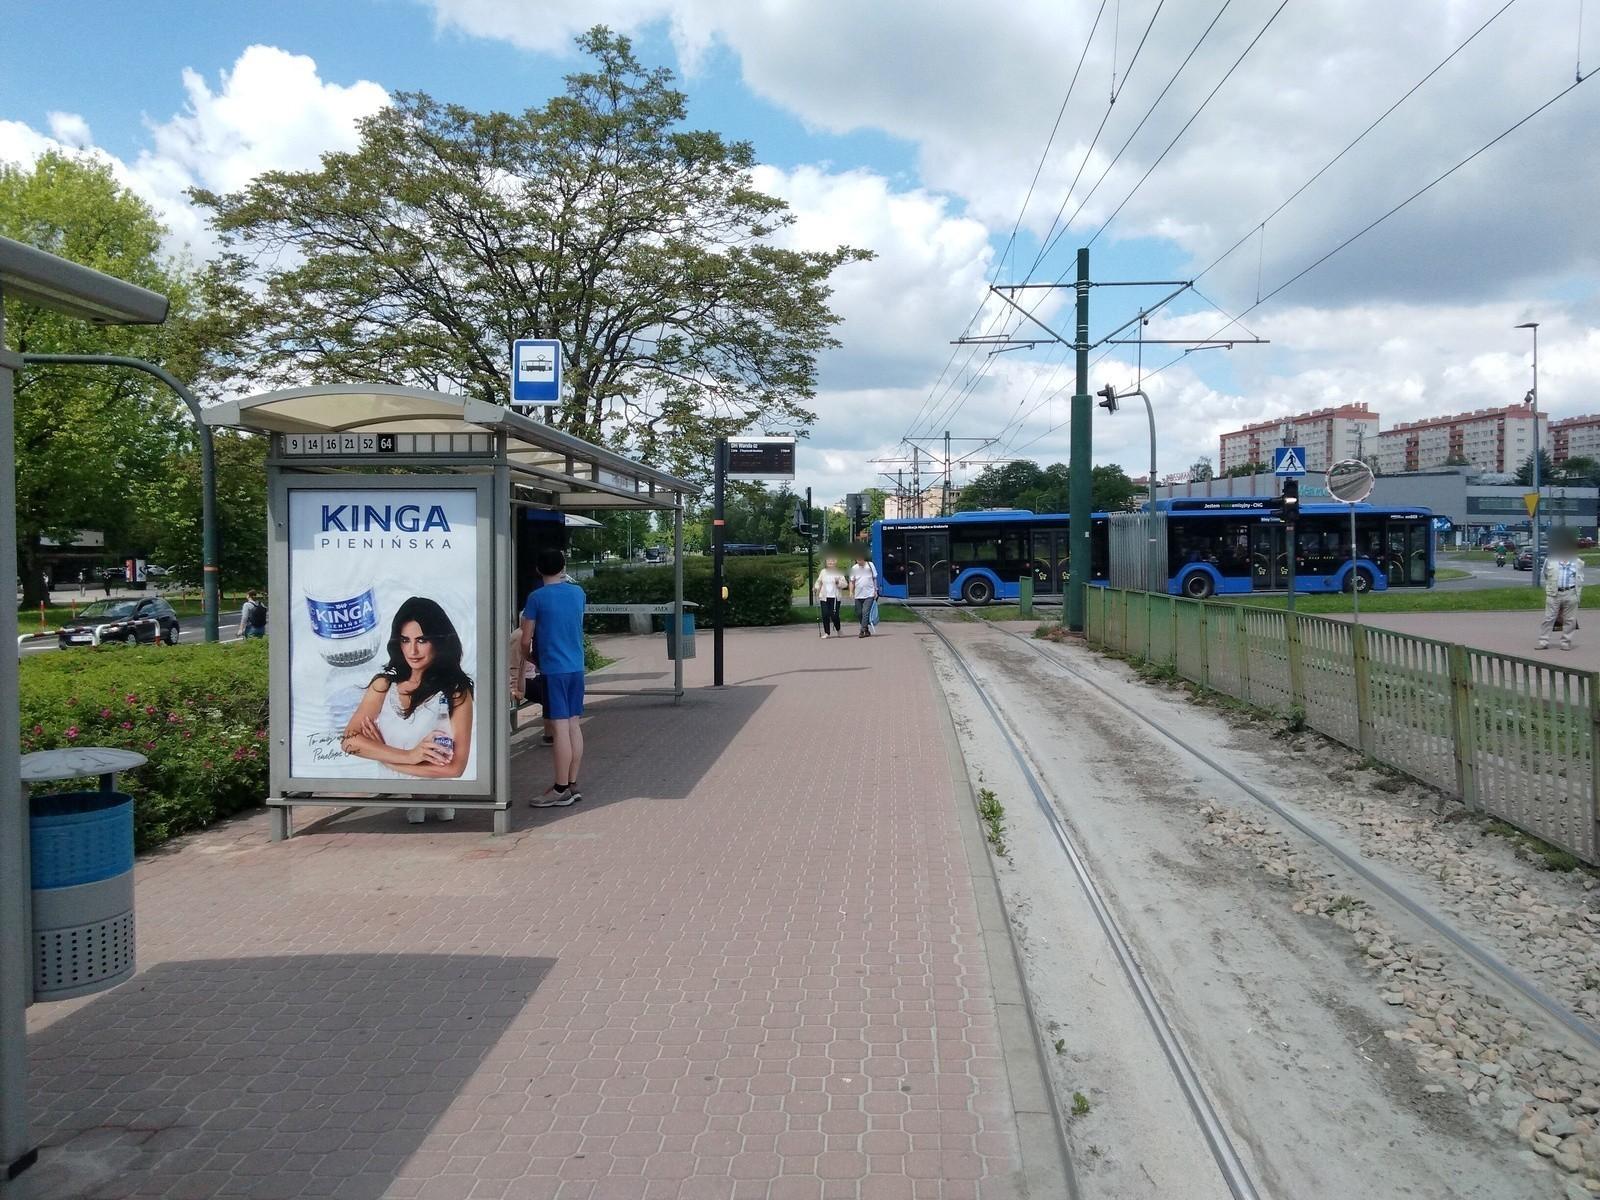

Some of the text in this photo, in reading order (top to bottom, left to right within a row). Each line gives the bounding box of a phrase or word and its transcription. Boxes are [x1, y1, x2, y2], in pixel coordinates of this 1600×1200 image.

[292, 438, 392, 450] 9 14 16 21 52 64
[322, 504, 452, 533] KINGA
[321, 535, 452, 549] PIENIŃSKA
[315, 600, 373, 624] KINGA
